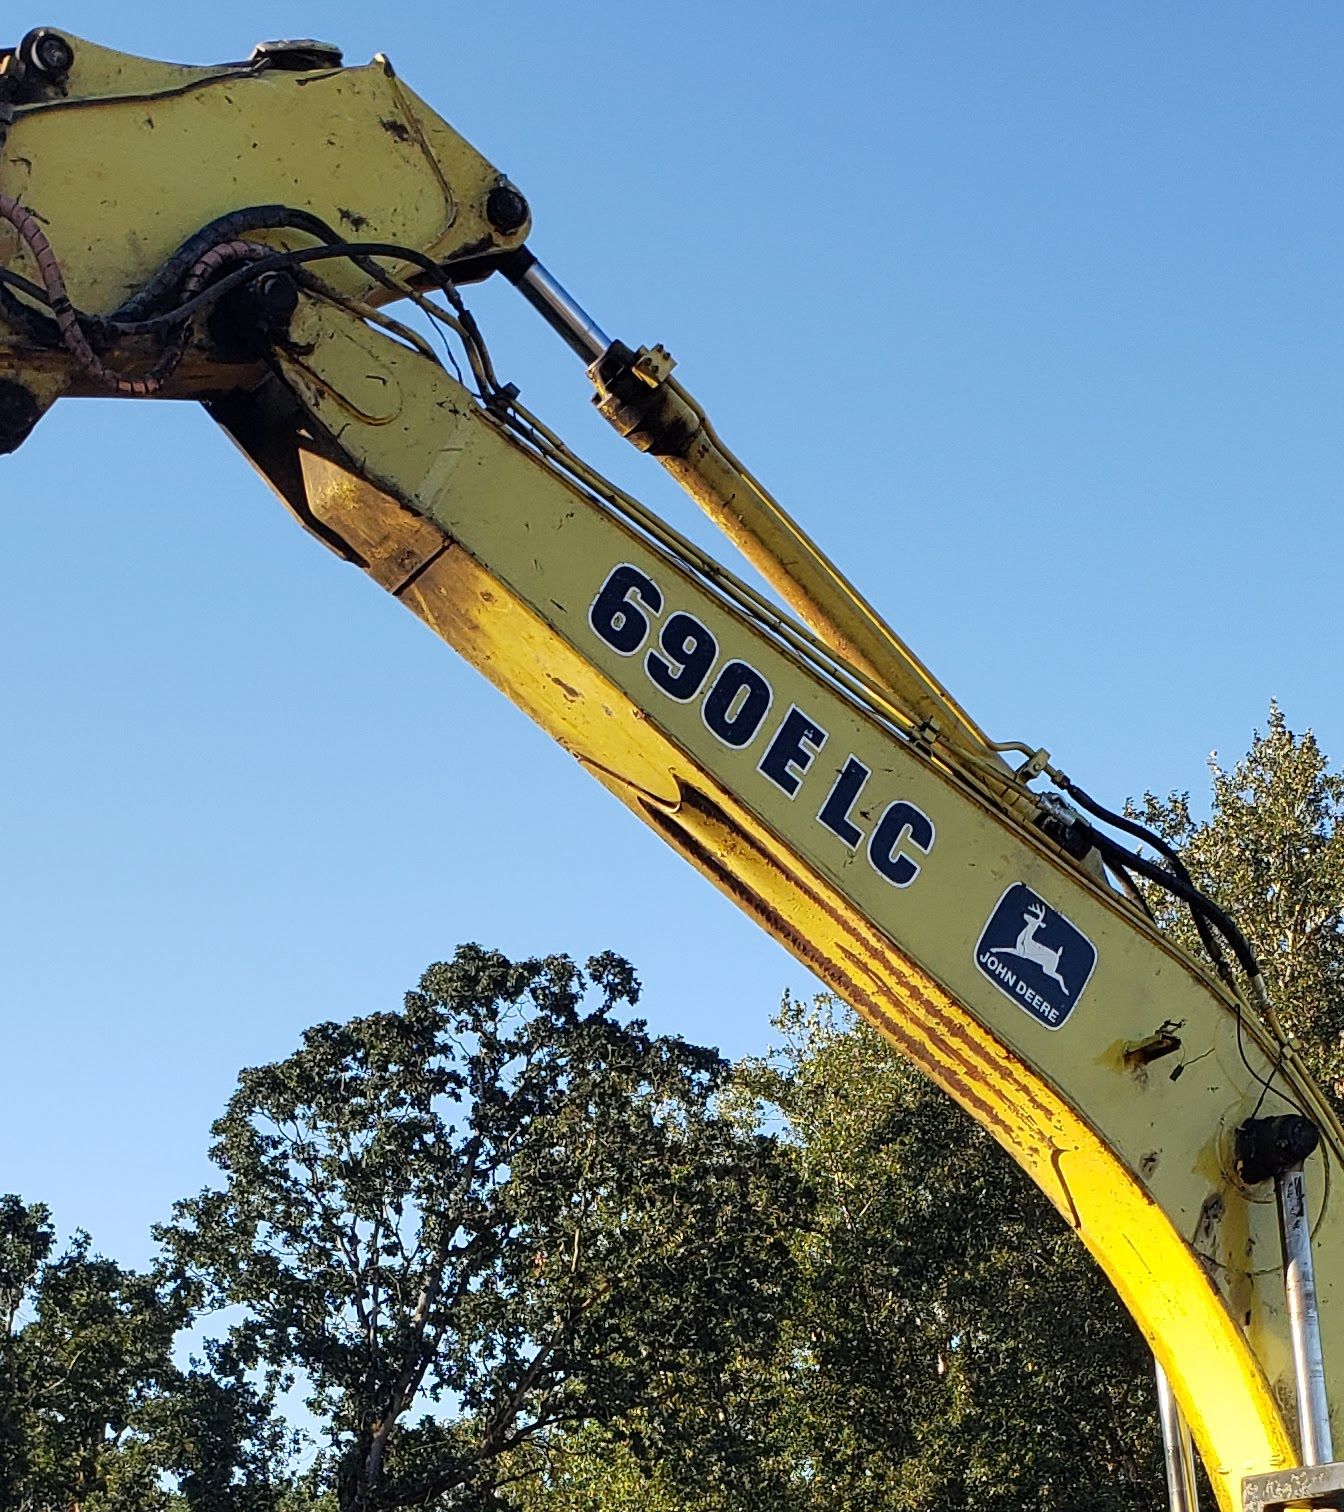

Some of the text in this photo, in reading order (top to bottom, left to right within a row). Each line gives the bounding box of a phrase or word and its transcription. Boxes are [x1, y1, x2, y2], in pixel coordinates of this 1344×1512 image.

[588, 562, 936, 889] 690E LC
[979, 951, 1060, 1024] JOHN DEERE
